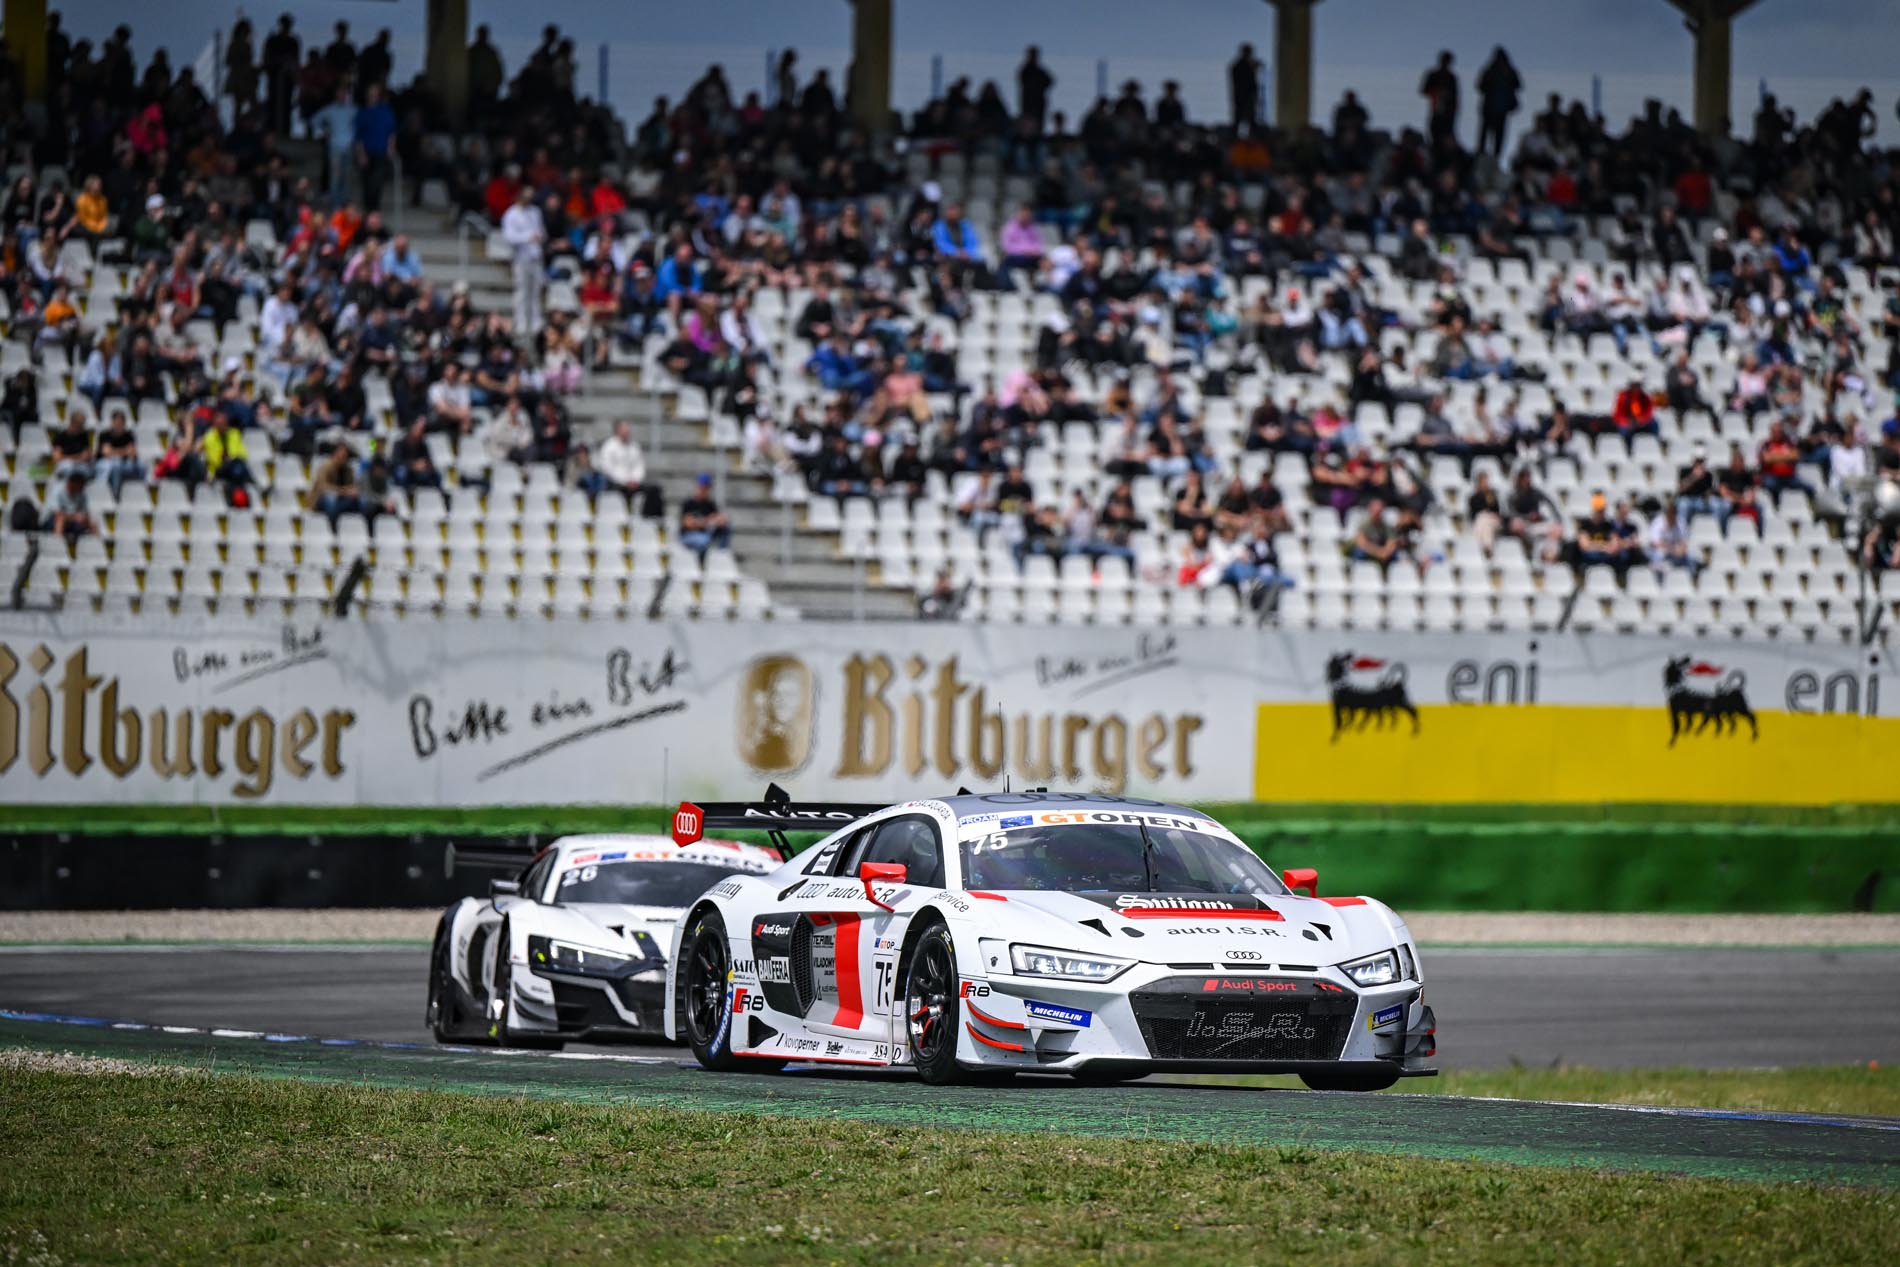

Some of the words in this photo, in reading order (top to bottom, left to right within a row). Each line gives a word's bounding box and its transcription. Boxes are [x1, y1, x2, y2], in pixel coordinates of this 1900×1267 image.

[1446, 640, 1540, 705] eni
[1785, 653, 1880, 717] eni
[408, 693, 511, 759] Bitte
[530, 690, 594, 726] ein
[606, 646, 692, 706] Bit
[833, 651, 1205, 797] Bitburger
[973, 831, 1008, 855] 75
[561, 865, 599, 888] 26
[827, 886, 859, 899] auto
[762, 924, 774, 934] Audi
[774, 926, 790, 936] Sport
[1168, 926, 1219, 936] auto
[1226, 926, 1287, 938] I.S.R.
[880, 939, 895, 949] GTOP
[758, 959, 789, 982] BAUFERA
[876, 961, 893, 1007] 75
[963, 985, 990, 997] R8
[1221, 979, 1254, 990] Audi
[1258, 980, 1297, 992] Sport
[739, 993, 764, 1011] R8
[1033, 1006, 1083, 1021] MICHELIN
